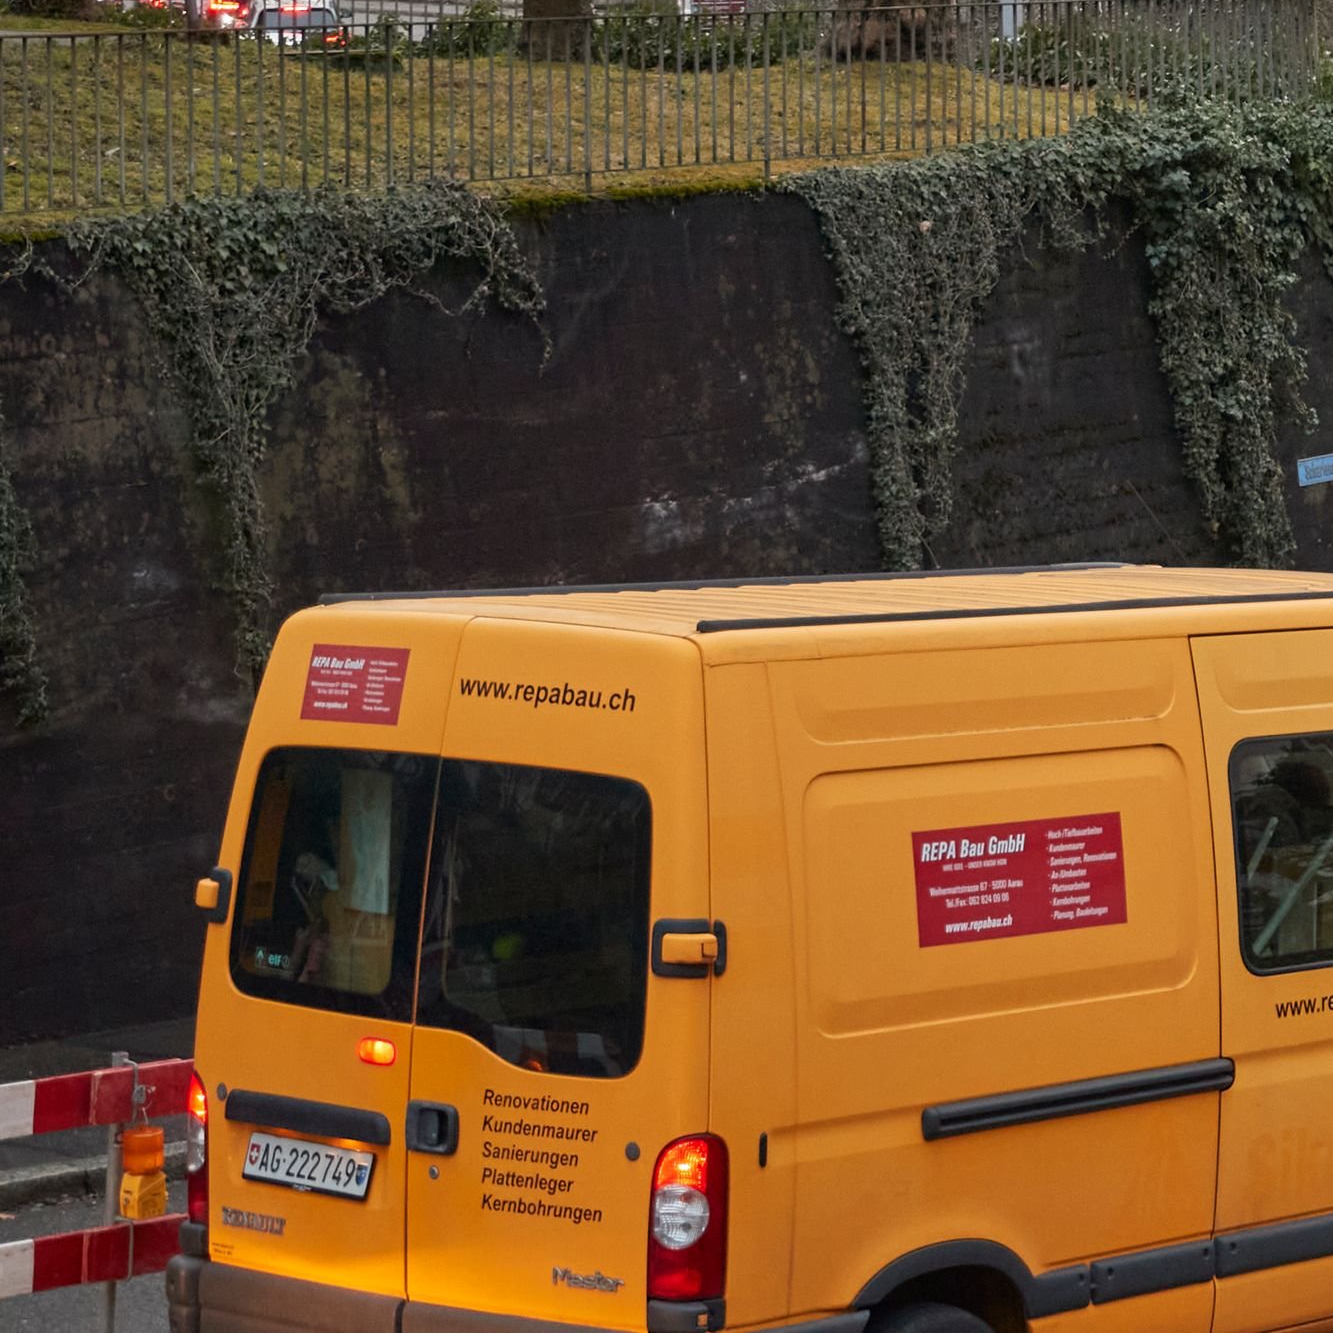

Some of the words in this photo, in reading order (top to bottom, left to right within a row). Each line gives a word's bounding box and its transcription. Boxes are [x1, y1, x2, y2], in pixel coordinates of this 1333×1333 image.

[460, 678, 636, 712] www.repabau.ch
[921, 840, 956, 862] REPA
[960, 839, 985, 858] Bau
[988, 833, 1026, 855] GmbH
[945, 913, 1013, 933] www.repabau.ch
[483, 1089, 590, 1115] Renovationen
[482, 1115, 598, 1142] Kundenmaurer
[482, 1141, 579, 1169] Sanierungen
[481, 1168, 574, 1195] Plattenleger
[481, 1194, 603, 1224] Kernbohrungen
